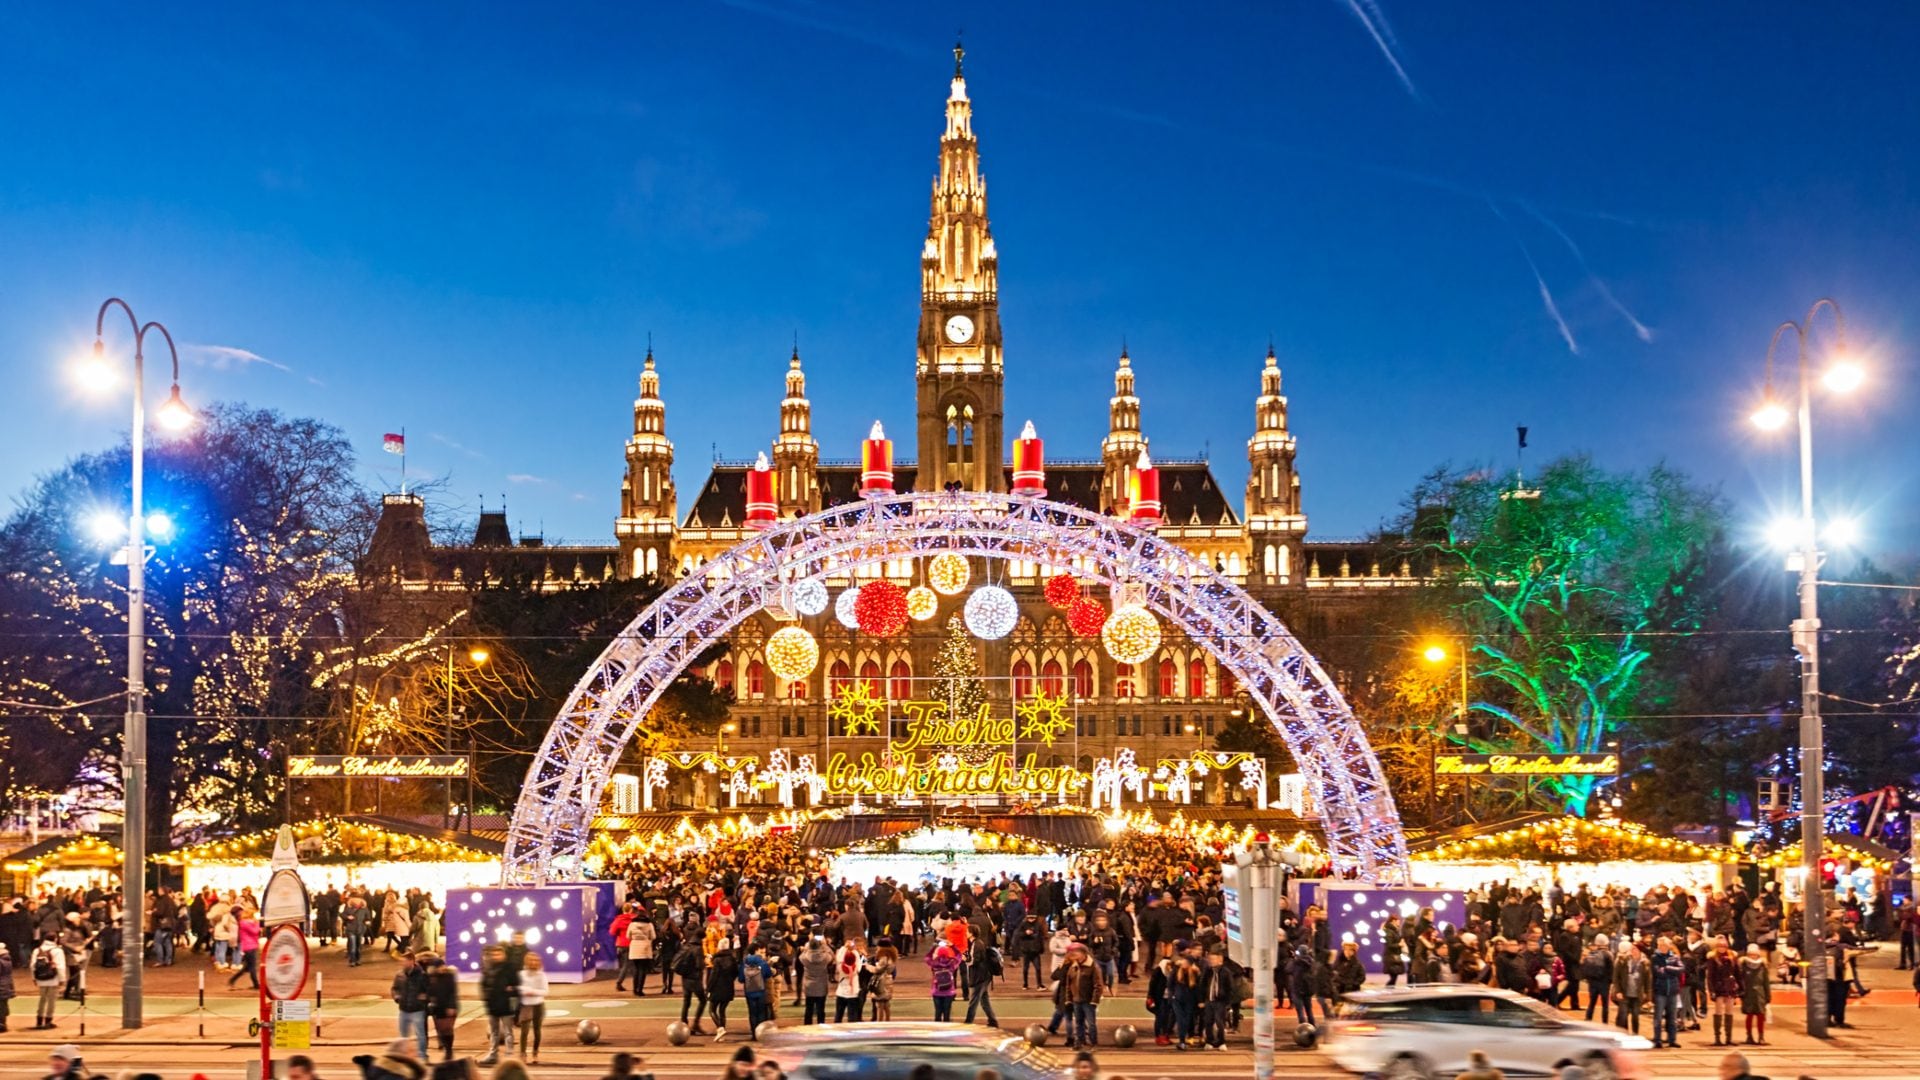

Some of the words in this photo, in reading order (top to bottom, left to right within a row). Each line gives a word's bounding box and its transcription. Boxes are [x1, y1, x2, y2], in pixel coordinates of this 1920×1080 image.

[890, 701, 1016, 752] Frohe
[288, 758, 341, 776] Wiener
[342, 756, 468, 776] Christkindlmarkt
[826, 751, 1078, 794] Weihnachten
[1435, 755, 1489, 774] Wiener
